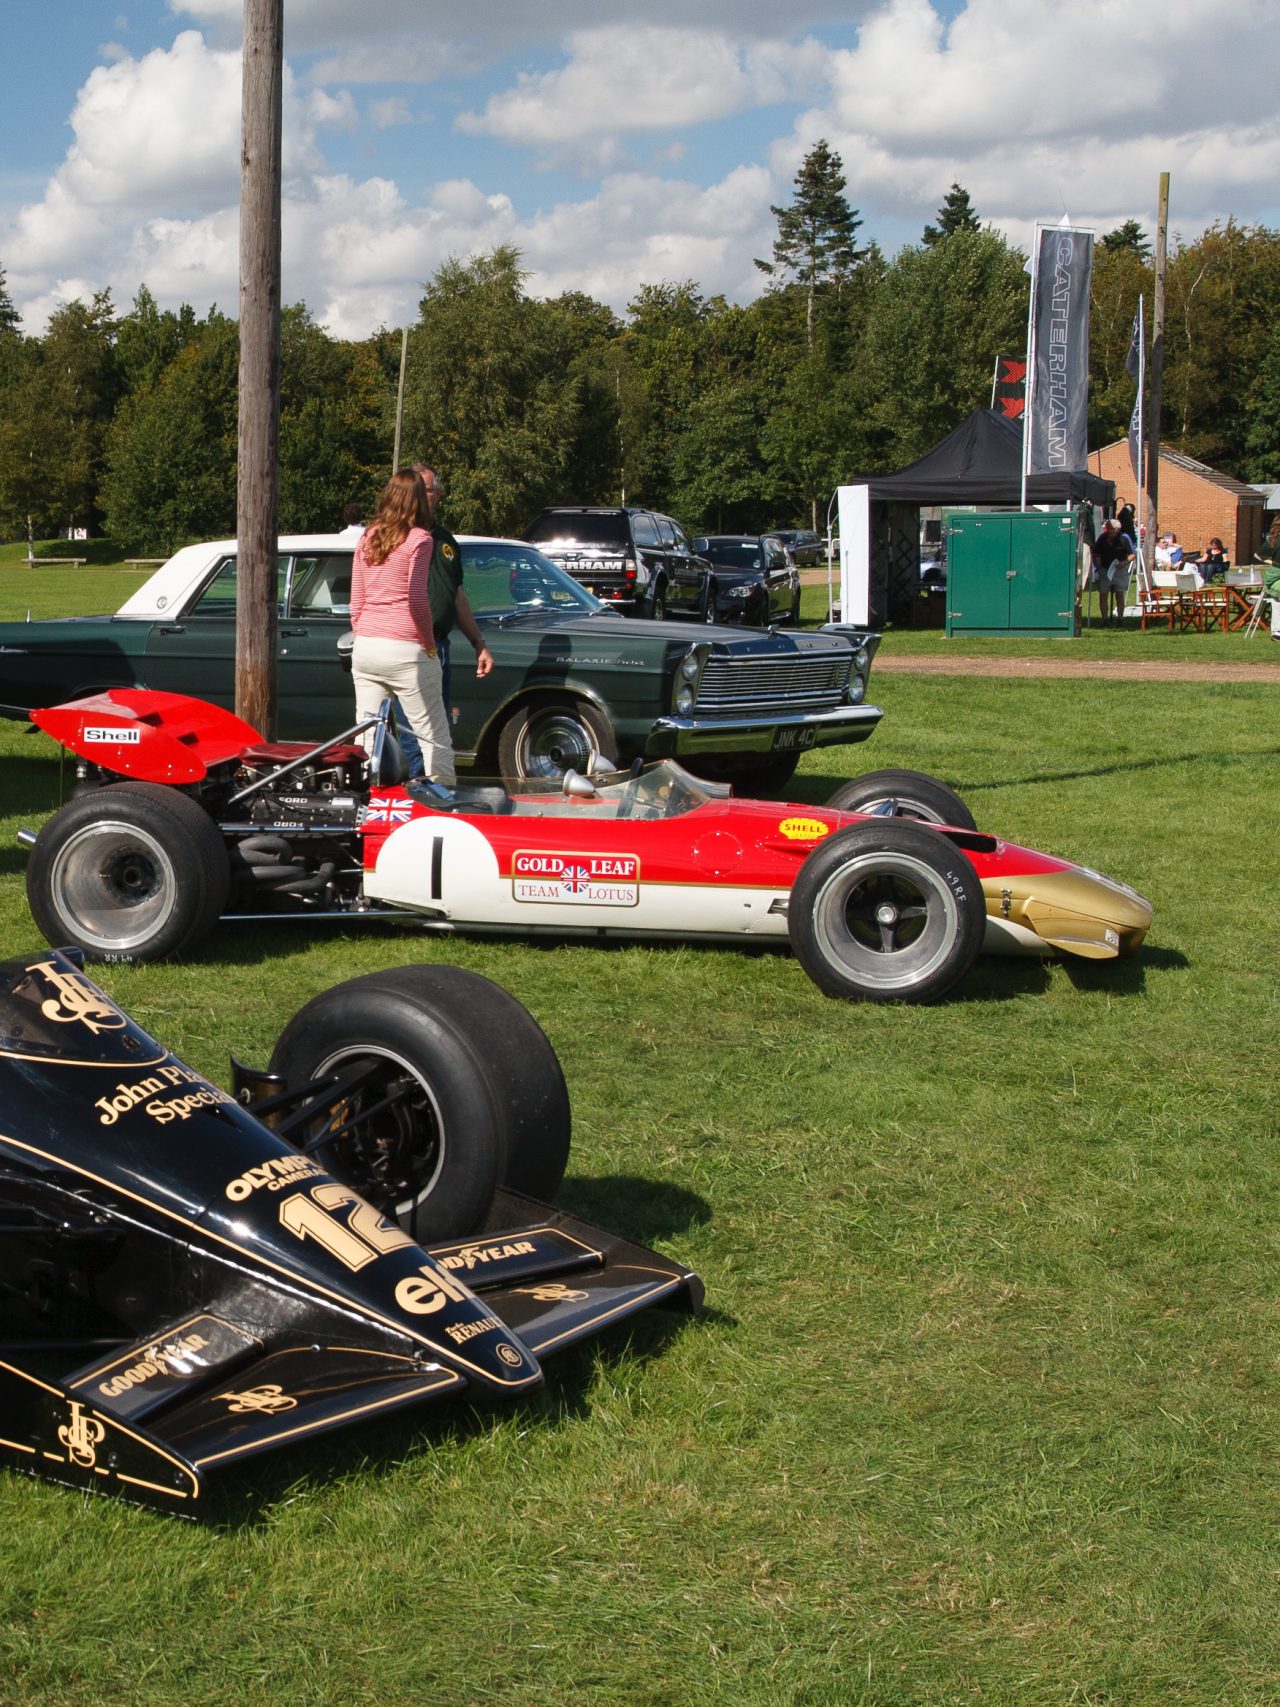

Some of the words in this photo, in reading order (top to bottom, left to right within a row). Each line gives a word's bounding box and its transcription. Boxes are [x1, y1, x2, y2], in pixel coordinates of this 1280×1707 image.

[1048, 237, 1074, 468] CATERHAM
[86, 729, 137, 741] Shell
[784, 823, 823, 833] SHELL
[517, 857, 565, 873] GOLD
[590, 859, 635, 875] LEAF
[518, 885, 560, 898] TEAM
[588, 887, 634, 901] LOTUS
[95, 1076, 179, 1125] John
[279, 1183, 420, 1273] 12
